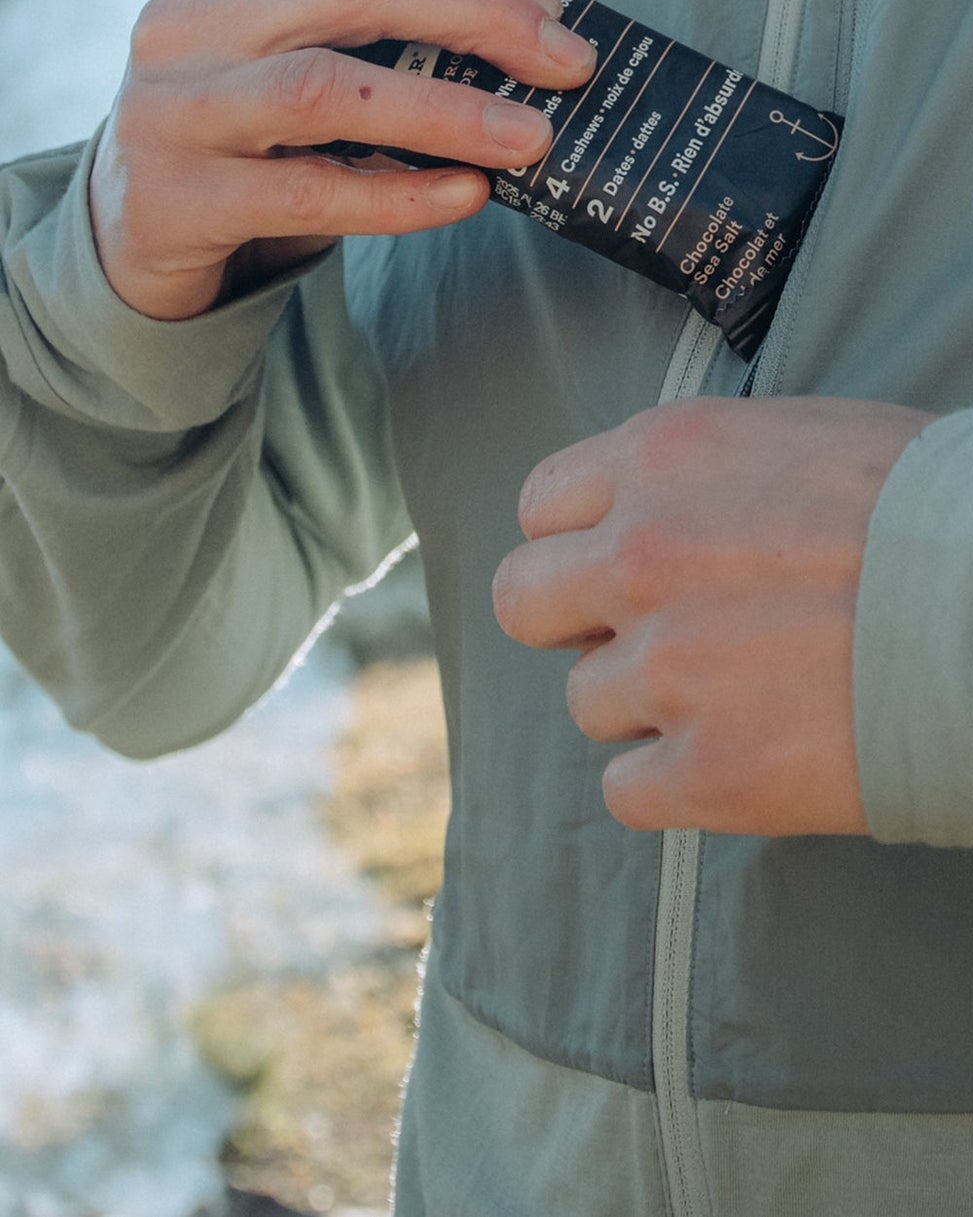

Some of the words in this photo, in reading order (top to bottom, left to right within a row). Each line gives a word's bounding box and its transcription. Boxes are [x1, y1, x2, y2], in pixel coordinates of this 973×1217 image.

[546, 176, 571, 200] 4
[561, 114, 604, 173] Cashews
[602, 84, 625, 109] noix
[617, 67, 634, 85] de
[628, 36, 654, 67] cajou
[586, 199, 614, 224] 2
[603, 155, 635, 196] Dates
[632, 111, 662, 150] dattes
[631, 215, 657, 243] No
[647, 180, 680, 215] B.S.
[671, 137, 703, 174] Rien
[680, 196, 734, 274] Chocolate
[694, 255, 721, 285] Sea
[715, 220, 743, 253] Salt
[715, 229, 769, 299] Chocolat
[764, 212, 779, 229] et
[764, 232, 786, 265] mer
